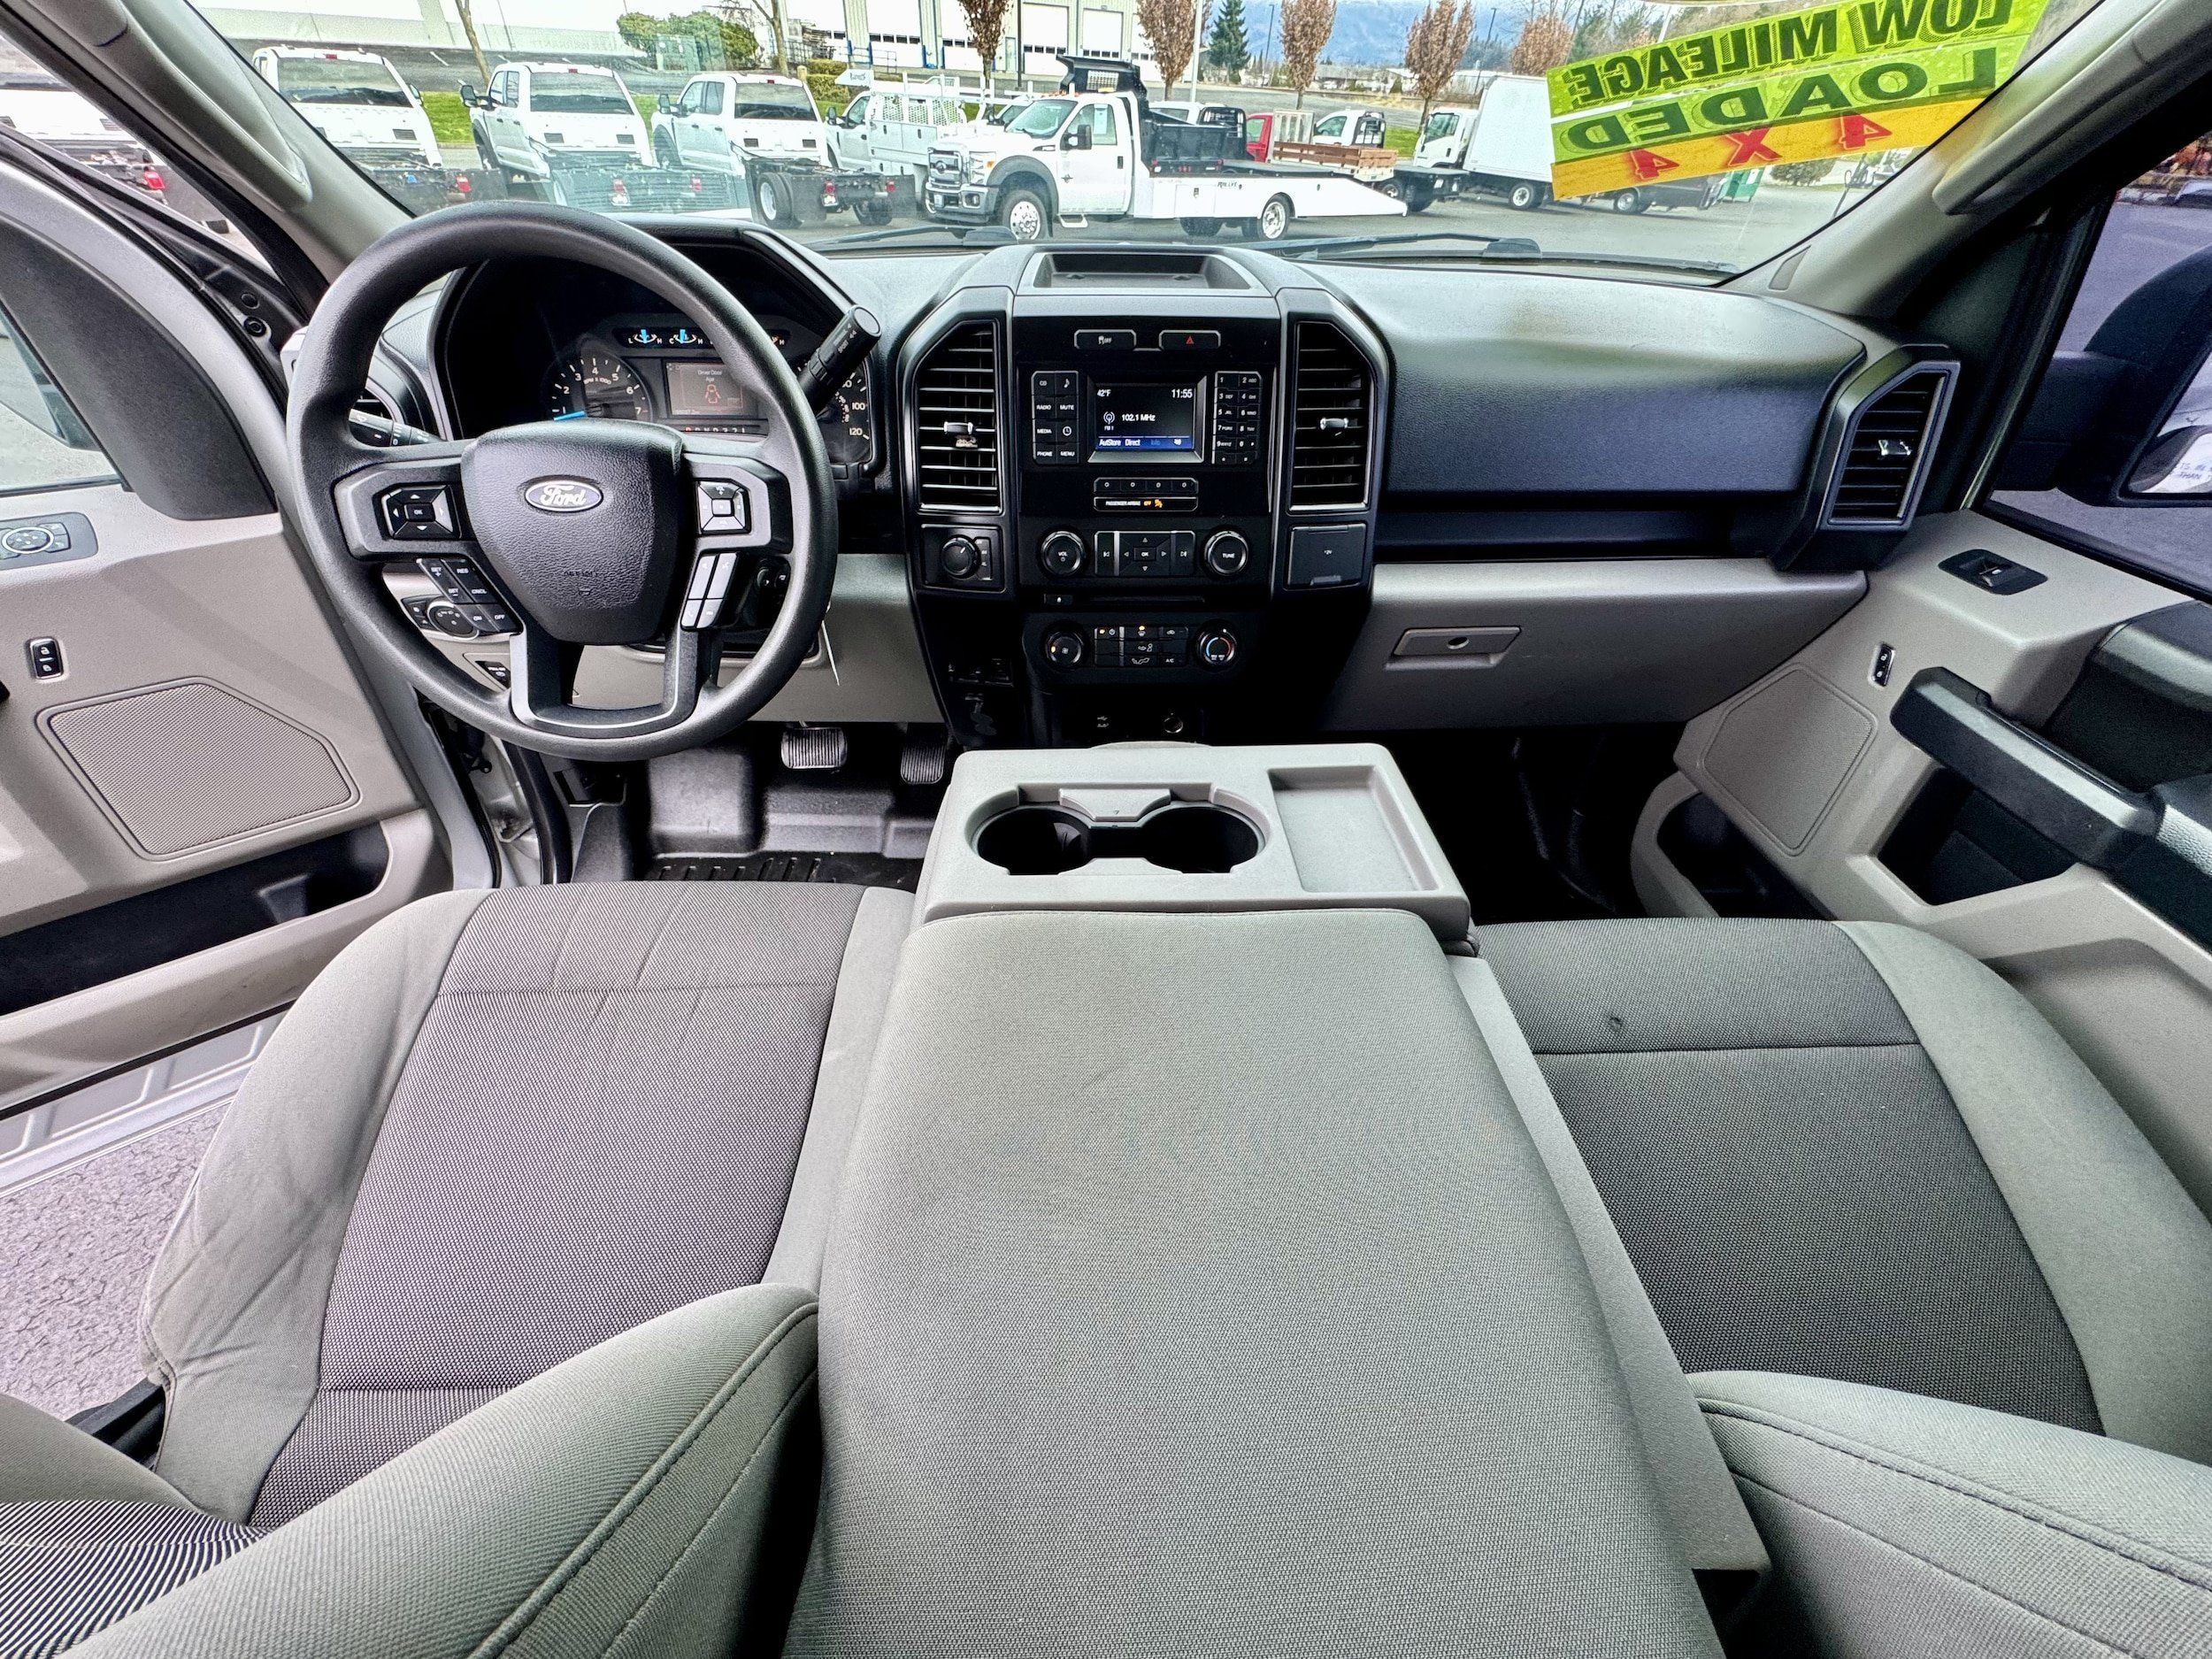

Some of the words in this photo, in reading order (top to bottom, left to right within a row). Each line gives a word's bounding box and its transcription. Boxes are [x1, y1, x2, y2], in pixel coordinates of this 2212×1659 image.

[1171, 388, 1194, 398] 11:55
[851, 402, 866, 411] 100
[540, 483, 588, 506] Ford
